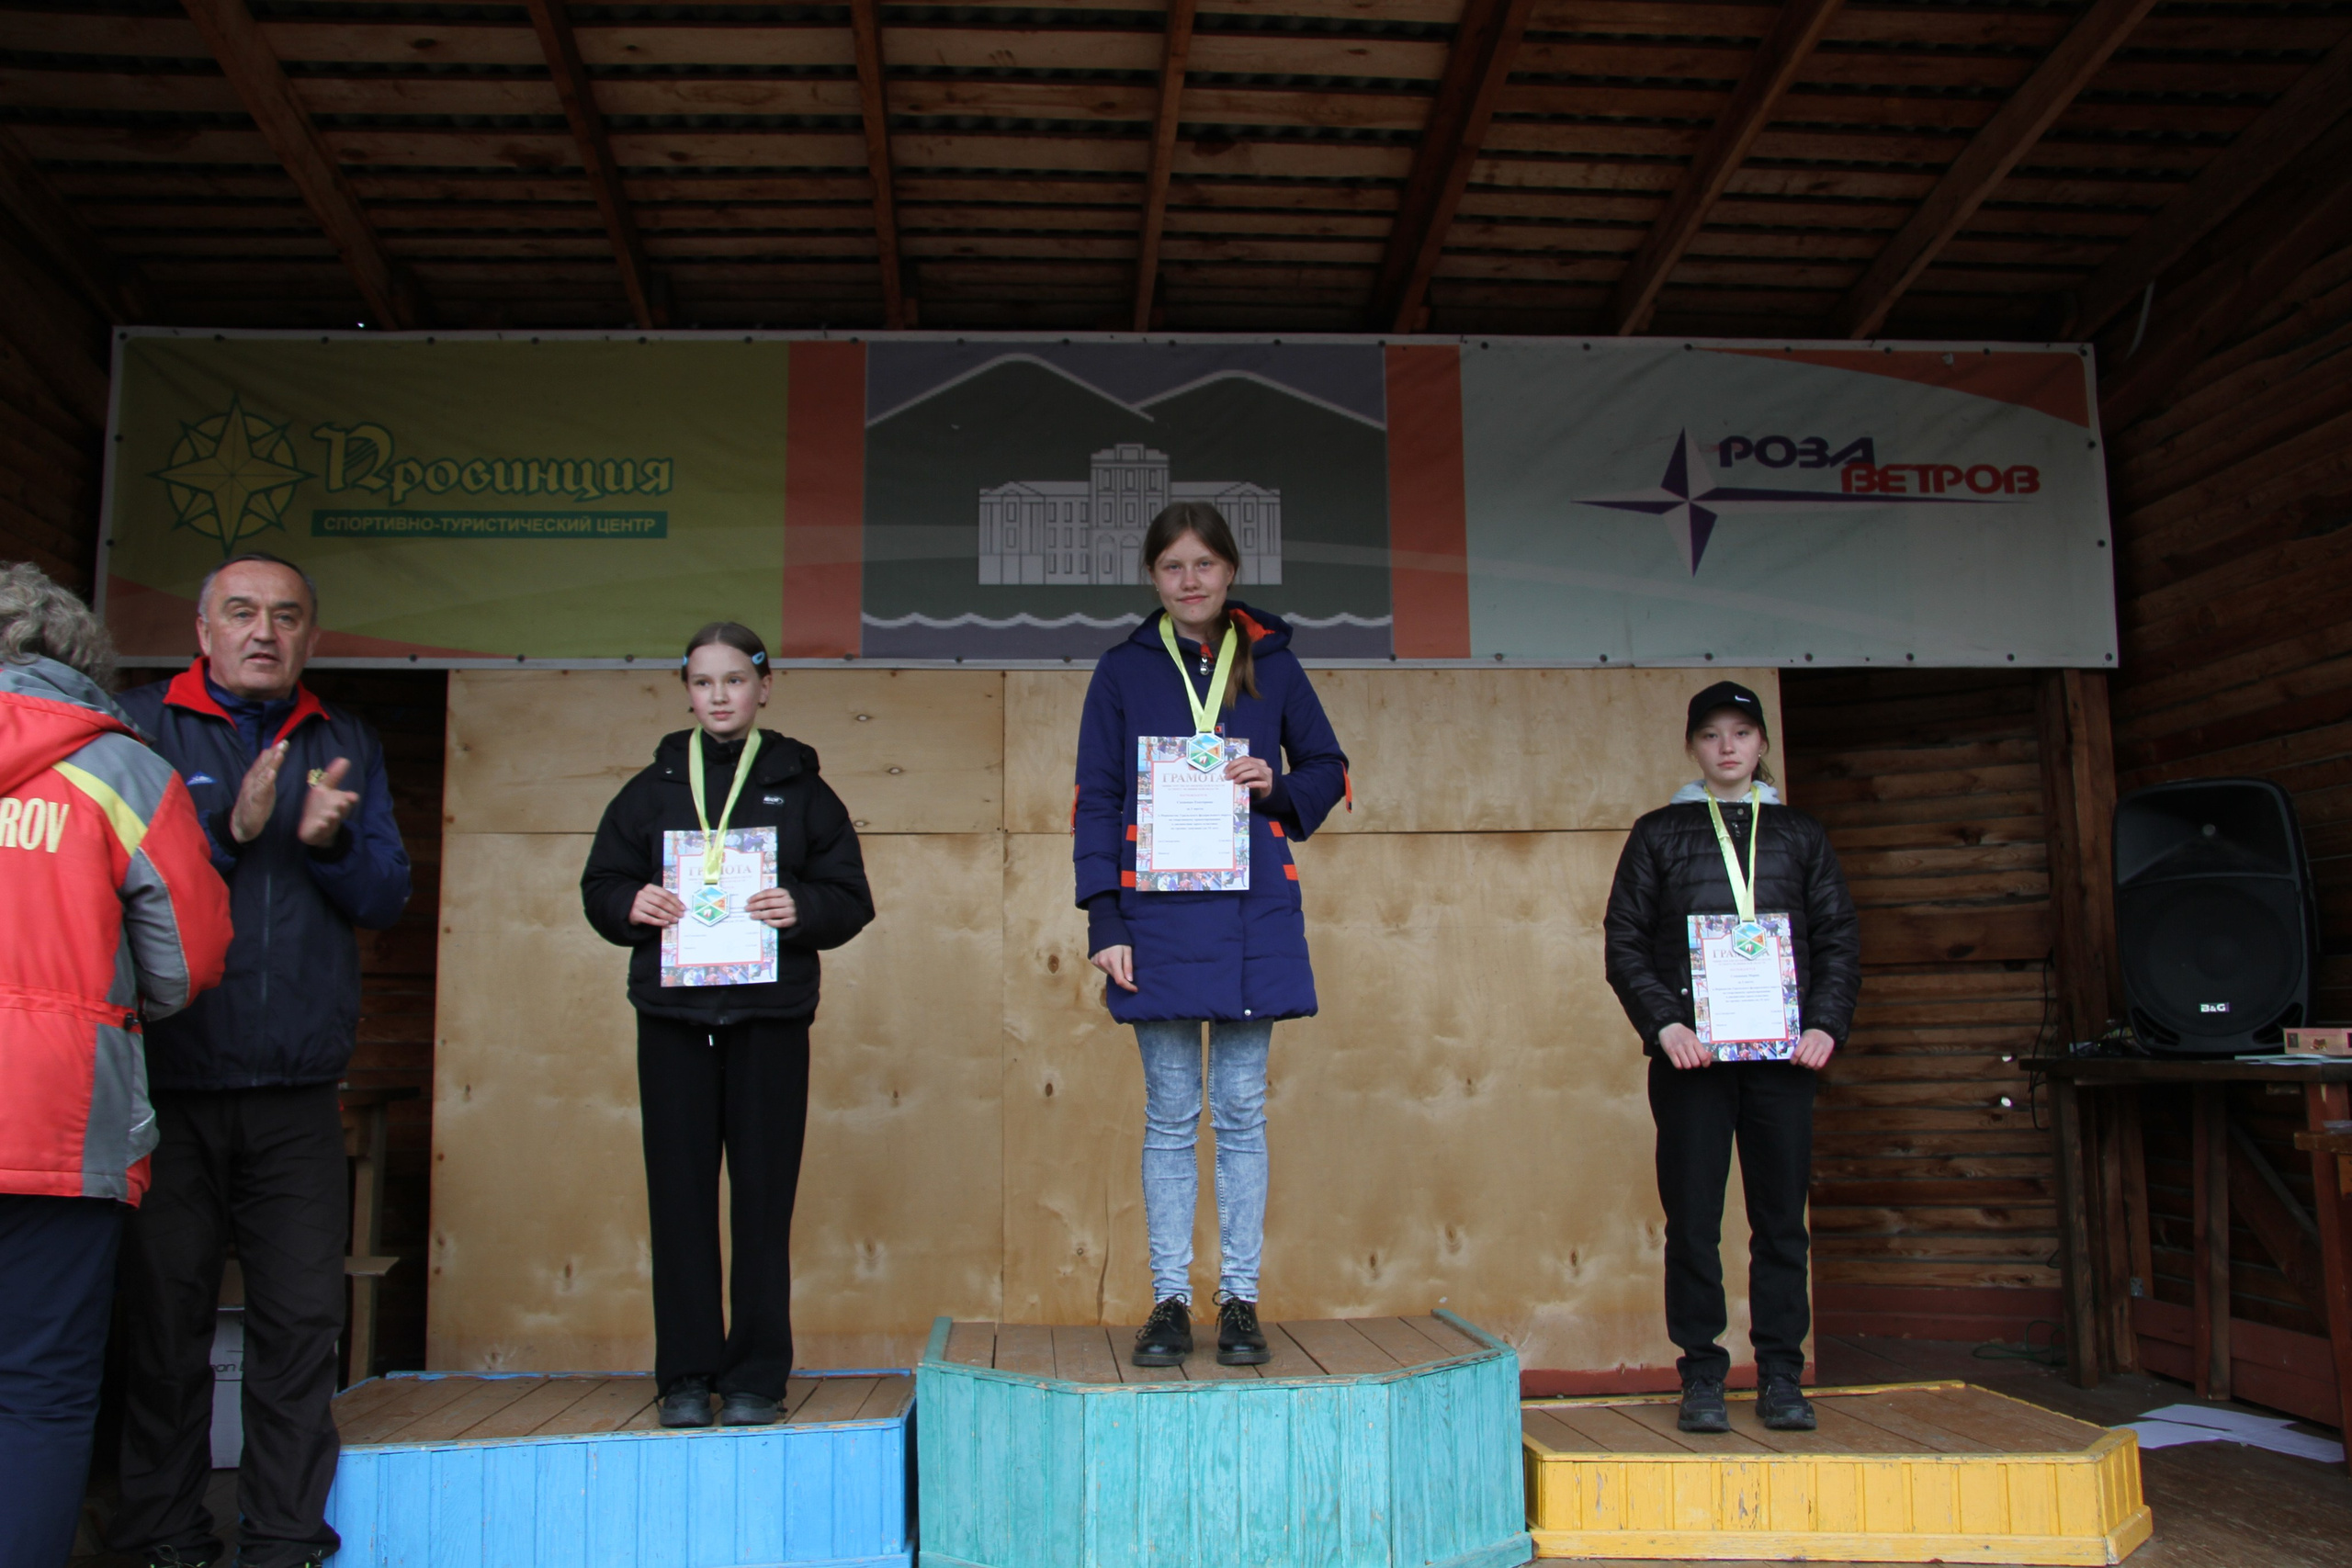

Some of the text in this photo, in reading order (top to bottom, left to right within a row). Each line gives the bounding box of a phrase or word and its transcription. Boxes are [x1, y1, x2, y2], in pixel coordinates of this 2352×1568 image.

[311, 422, 674, 505] Провинция
[1719, 435, 1876, 468] РОЗА
[1840, 464, 2041, 494] ВЕТРОВ
[322, 515, 657, 535] СПОРТИВНО-ТУРИСТИЧЕСКИЙ ЦЕНТР
[1162, 773, 1226, 783] ГРАМОТА
[689, 864, 752, 876] ГРОТА
